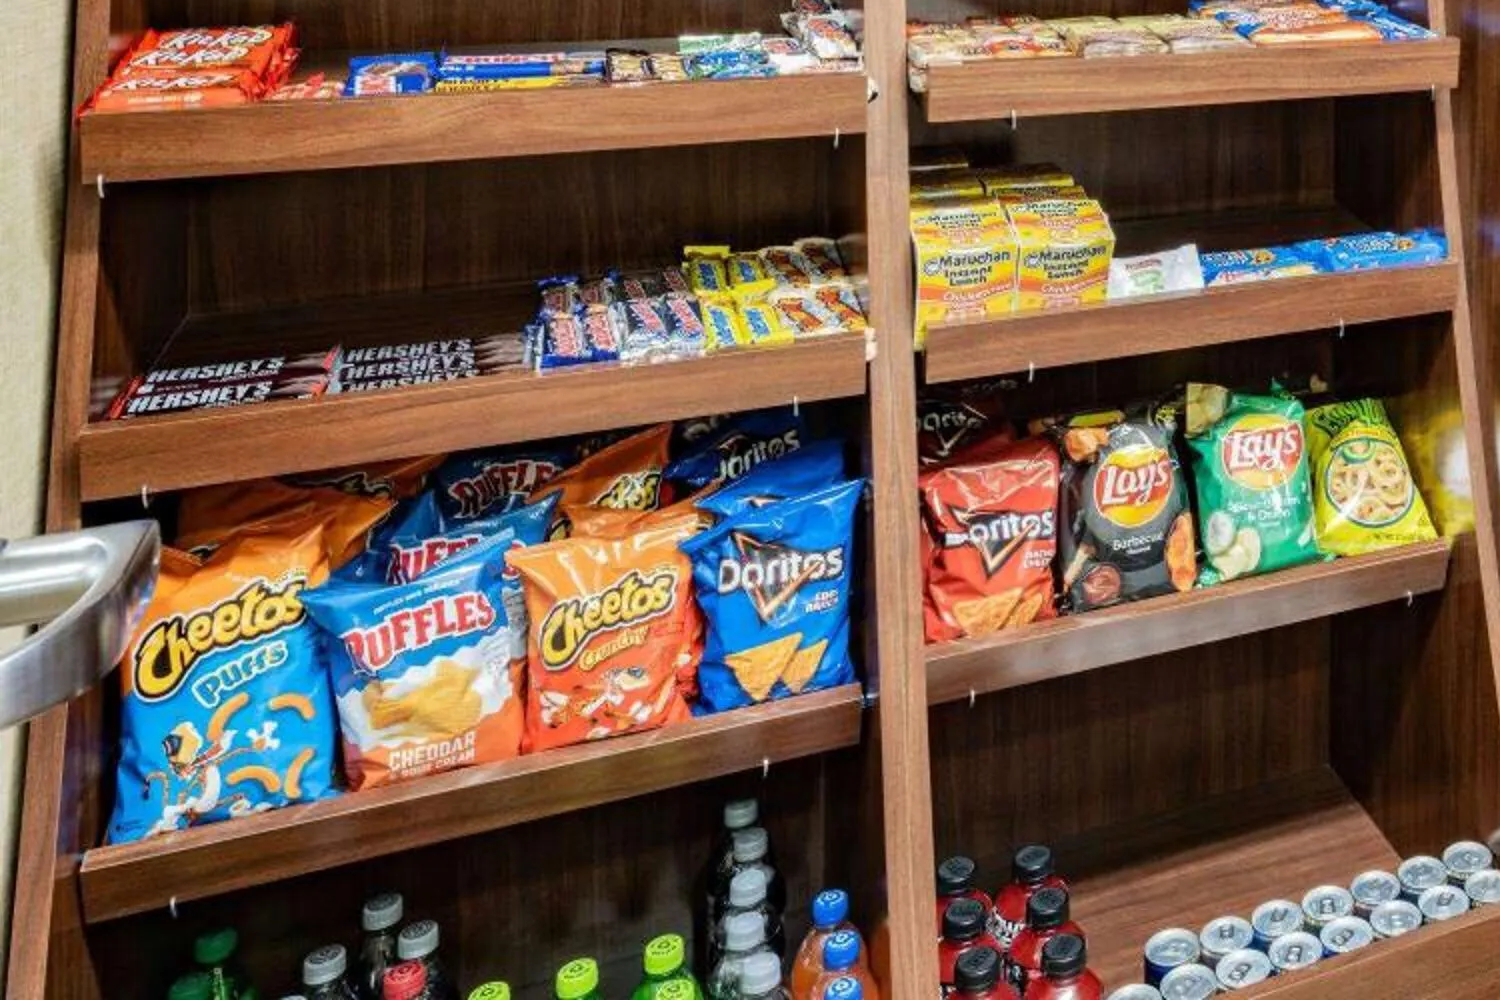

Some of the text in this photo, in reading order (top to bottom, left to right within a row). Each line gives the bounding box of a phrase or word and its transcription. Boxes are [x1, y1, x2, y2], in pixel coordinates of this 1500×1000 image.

[940, 250, 1011, 267] Maruchan
[147, 356, 286, 383] HERSHEY'S
[345, 352, 476, 379] HERSHEY'S
[346, 338, 473, 362] HERSHEY'S
[128, 380, 274, 413] HERSHEY'S
[1228, 423, 1299, 471] Lay's
[1101, 457, 1170, 507] Lay's
[717, 547, 845, 594] Doritos
[137, 581, 305, 699] Cheetos
[345, 593, 495, 672] RUFFLES
[543, 576, 674, 665] Cheetos
[192, 641, 290, 707] Puffs
[388, 731, 477, 770] CHEDDAR
